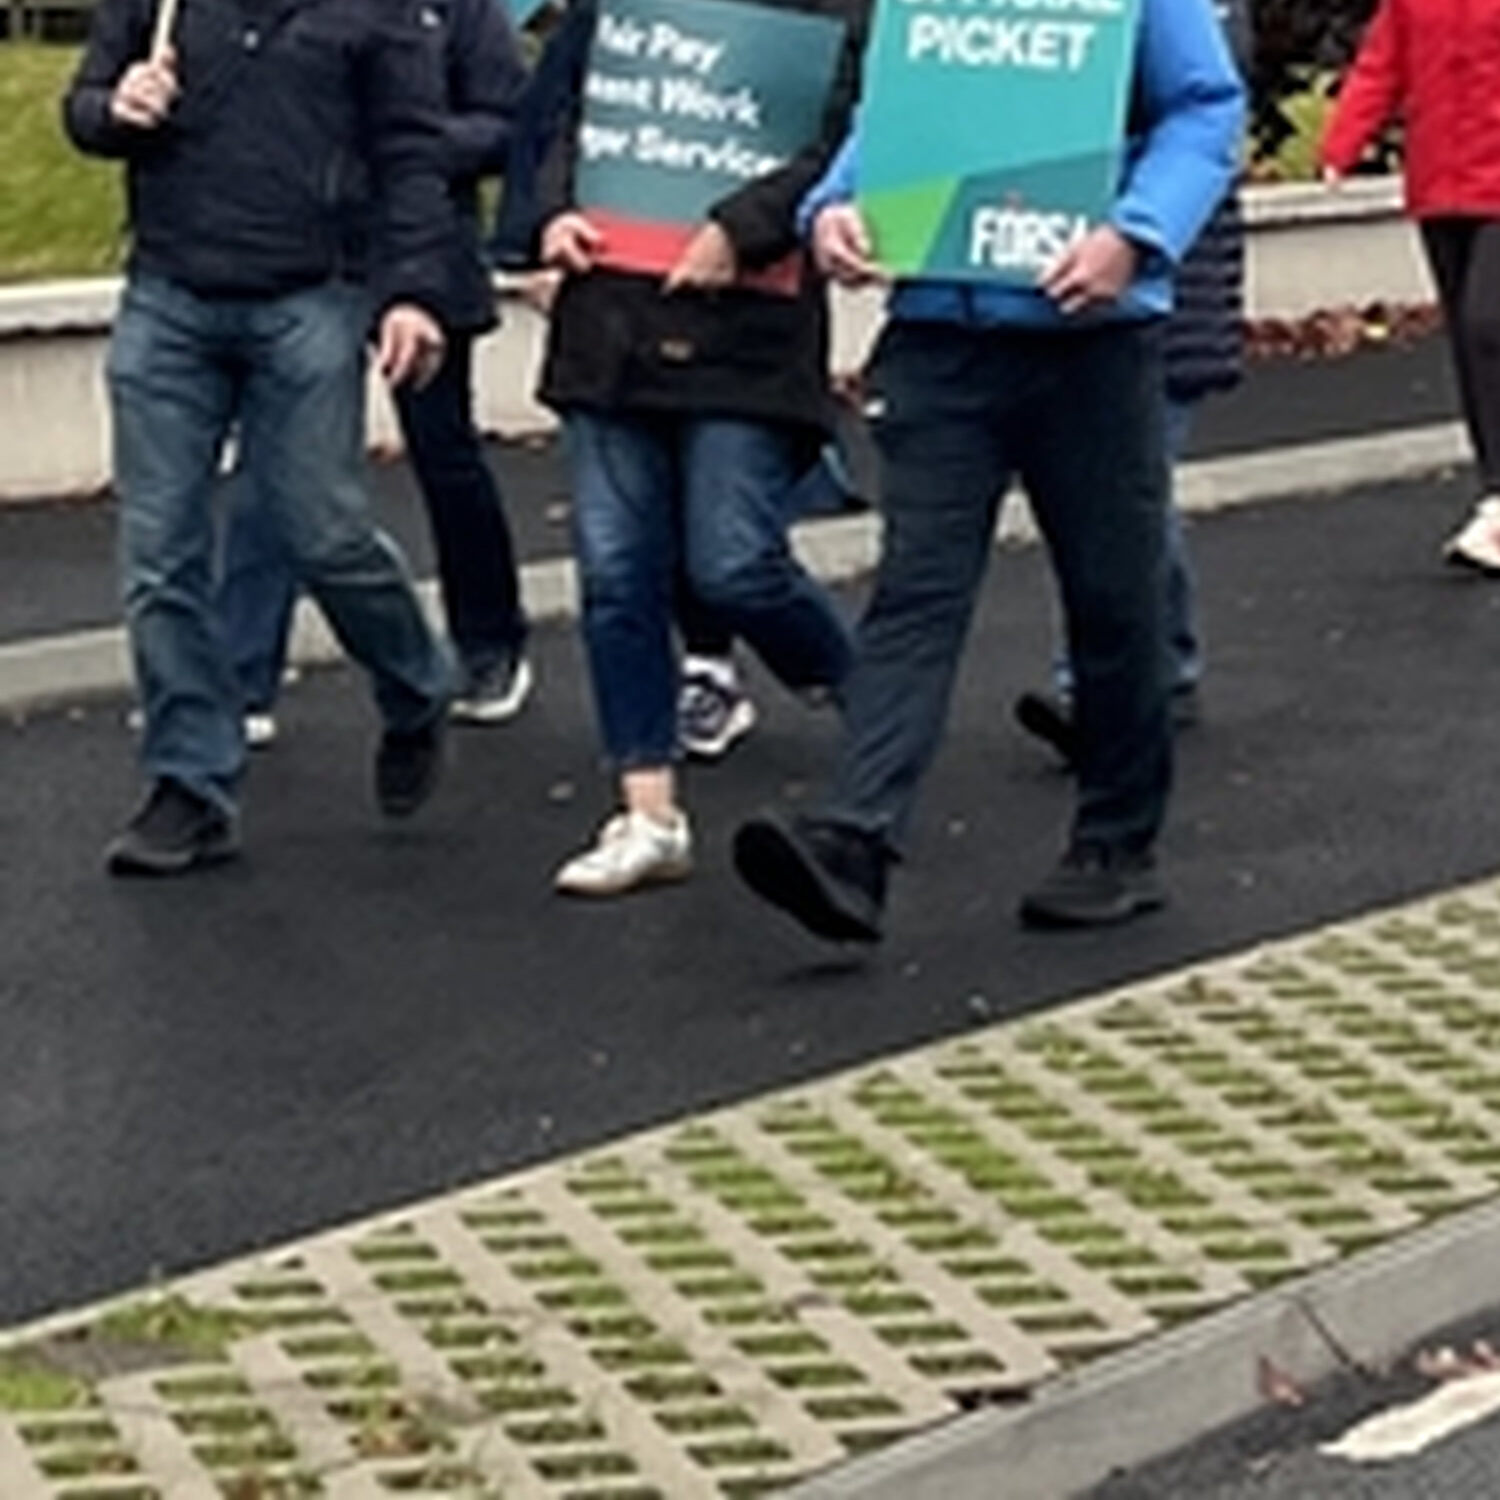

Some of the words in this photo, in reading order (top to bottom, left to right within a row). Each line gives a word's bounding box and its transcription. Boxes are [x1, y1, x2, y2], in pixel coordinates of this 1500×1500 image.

[647, 20, 727, 74] Pay
[907, 11, 1096, 73] PICKET
[659, 76, 761, 130] Work
